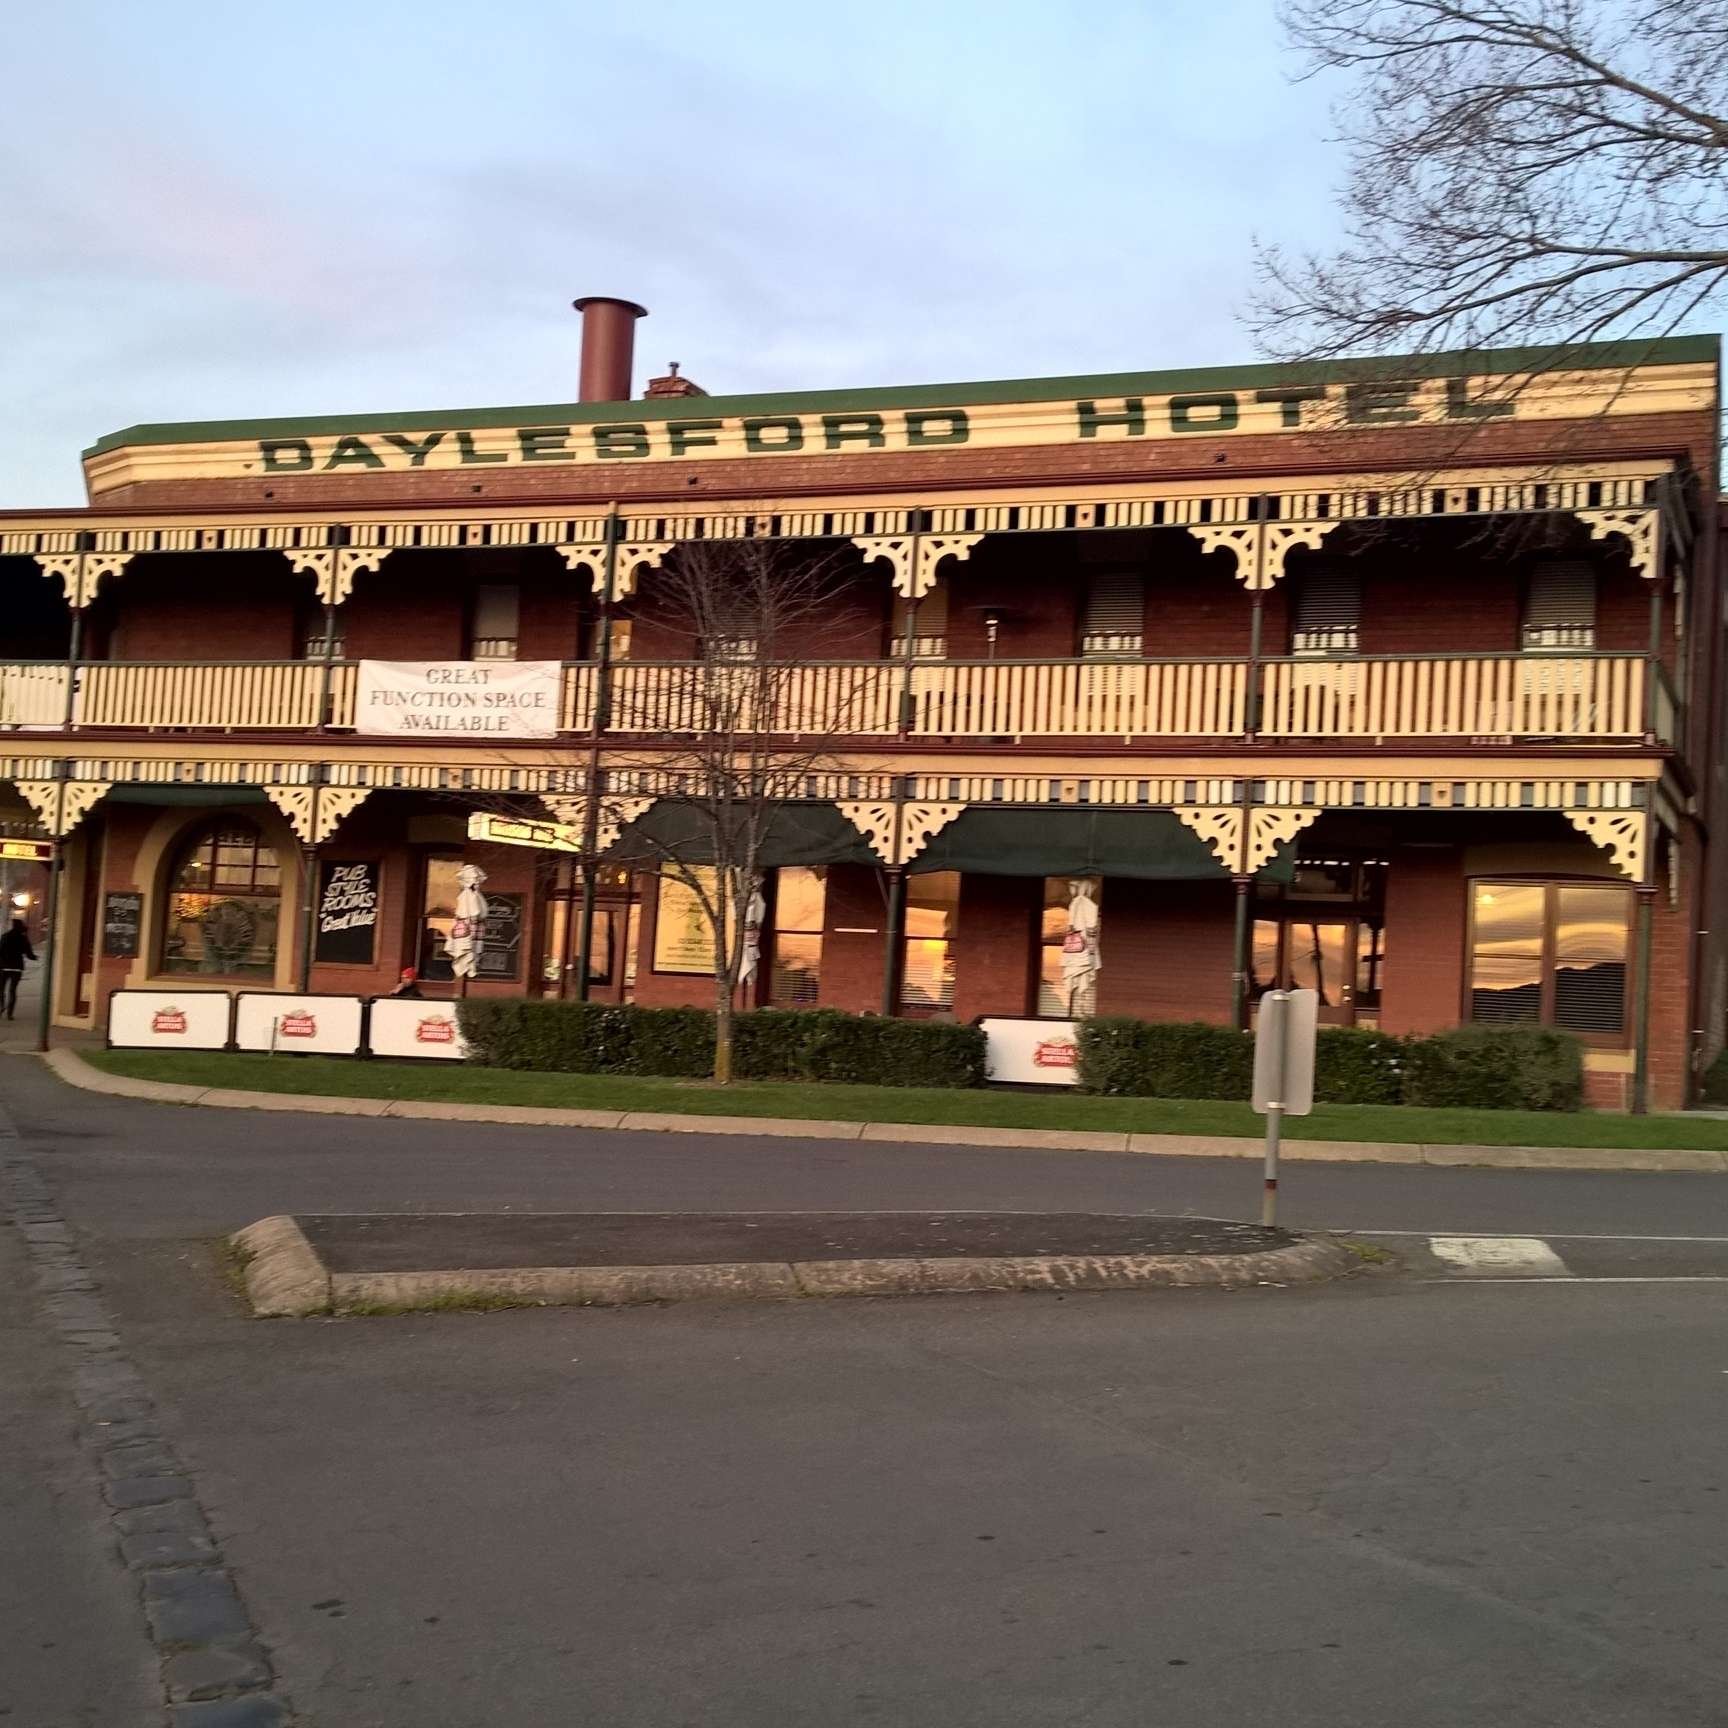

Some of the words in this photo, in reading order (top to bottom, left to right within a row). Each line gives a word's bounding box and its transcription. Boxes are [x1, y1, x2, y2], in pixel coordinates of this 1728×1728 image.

[259, 409, 969, 472] DAYLESFORD
[1078, 378, 1515, 438] HOTEL
[426, 668, 493, 685] GREAT
[370, 690, 478, 708] FUNCTION
[483, 691, 546, 708] SPACE
[400, 713, 511, 732] AVAILABLE
[331, 864, 368, 882] PUB
[324, 879, 371, 897] STYLE
[320, 892, 376, 912] ROOMS
